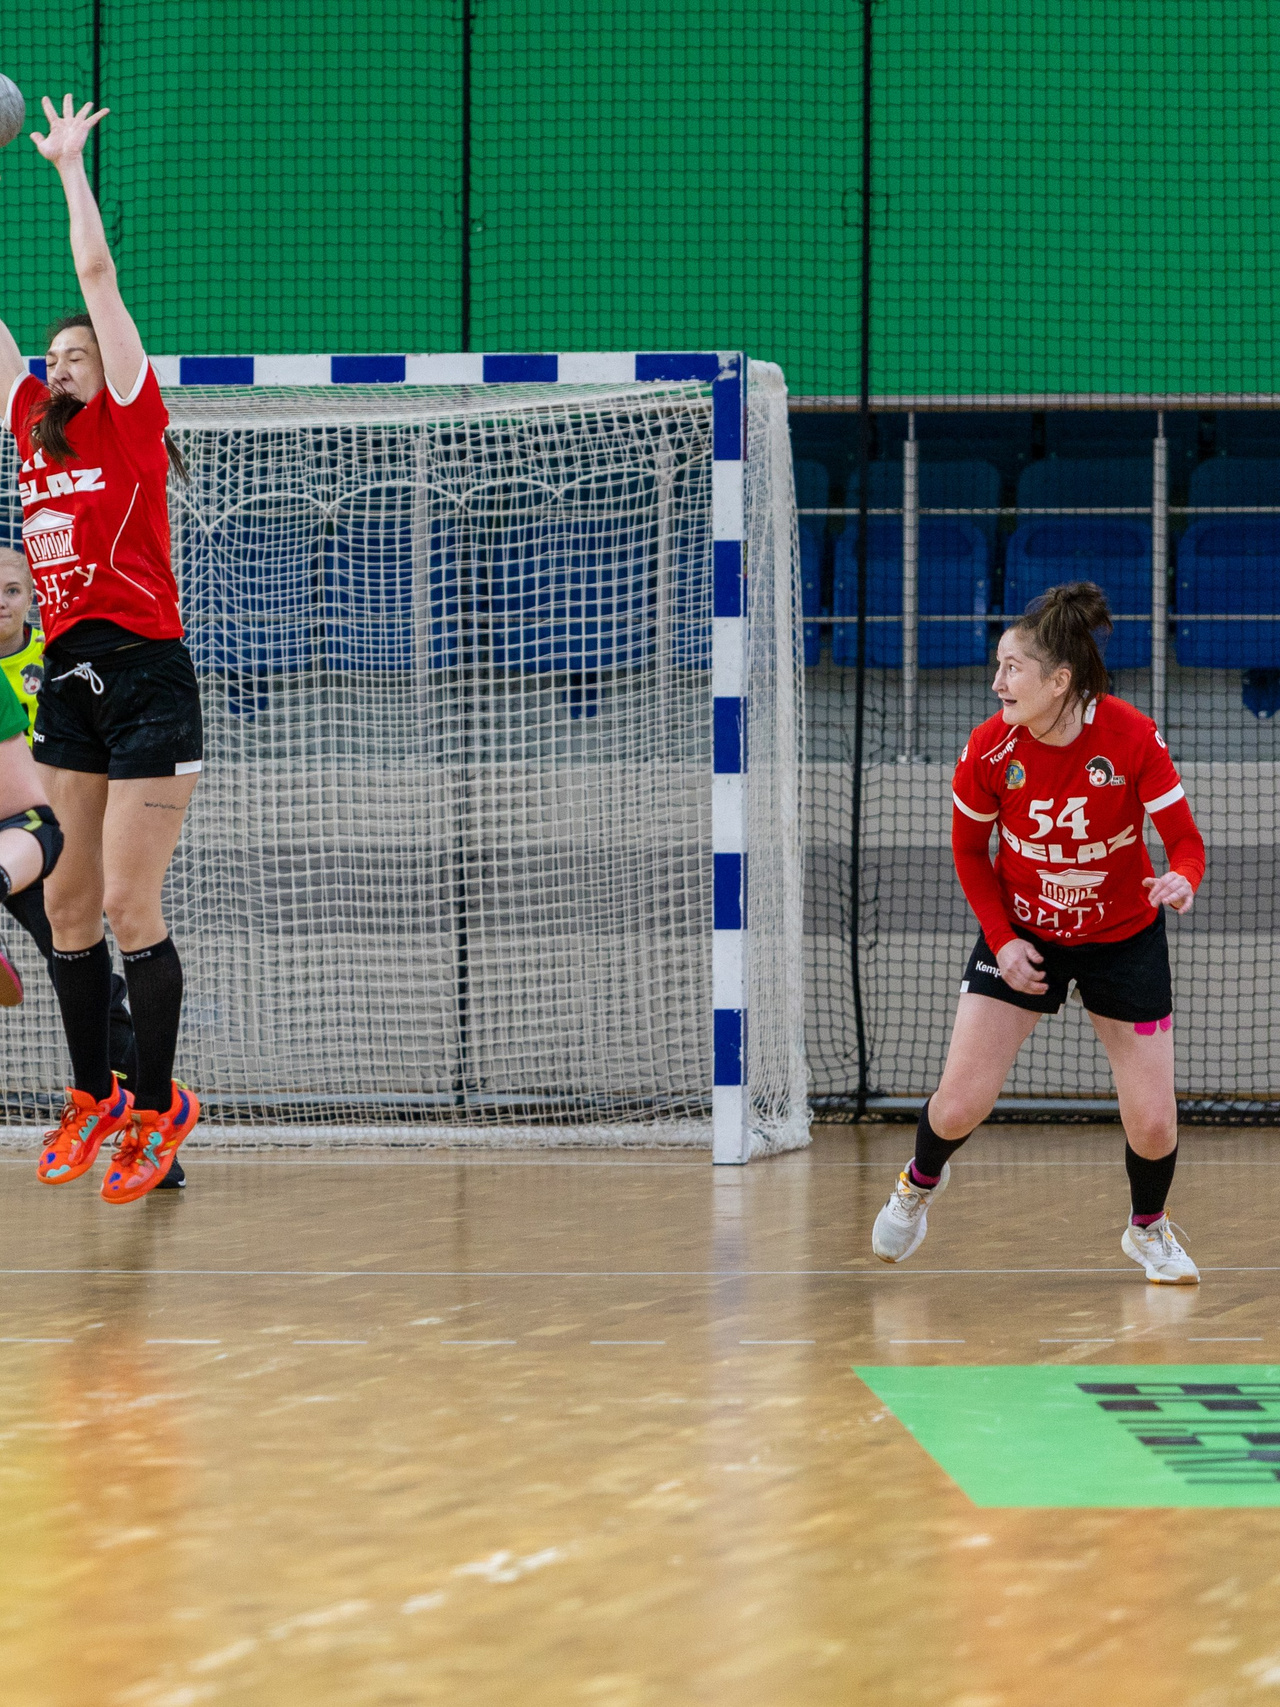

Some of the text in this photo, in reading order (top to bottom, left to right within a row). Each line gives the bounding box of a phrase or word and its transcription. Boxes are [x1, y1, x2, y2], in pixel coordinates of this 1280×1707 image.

[19, 467, 106, 507] ELAZ
[1028, 796, 1090, 840] 54
[1001, 824, 1138, 865] BELAZ
[975, 960, 1001, 978] Kemp
